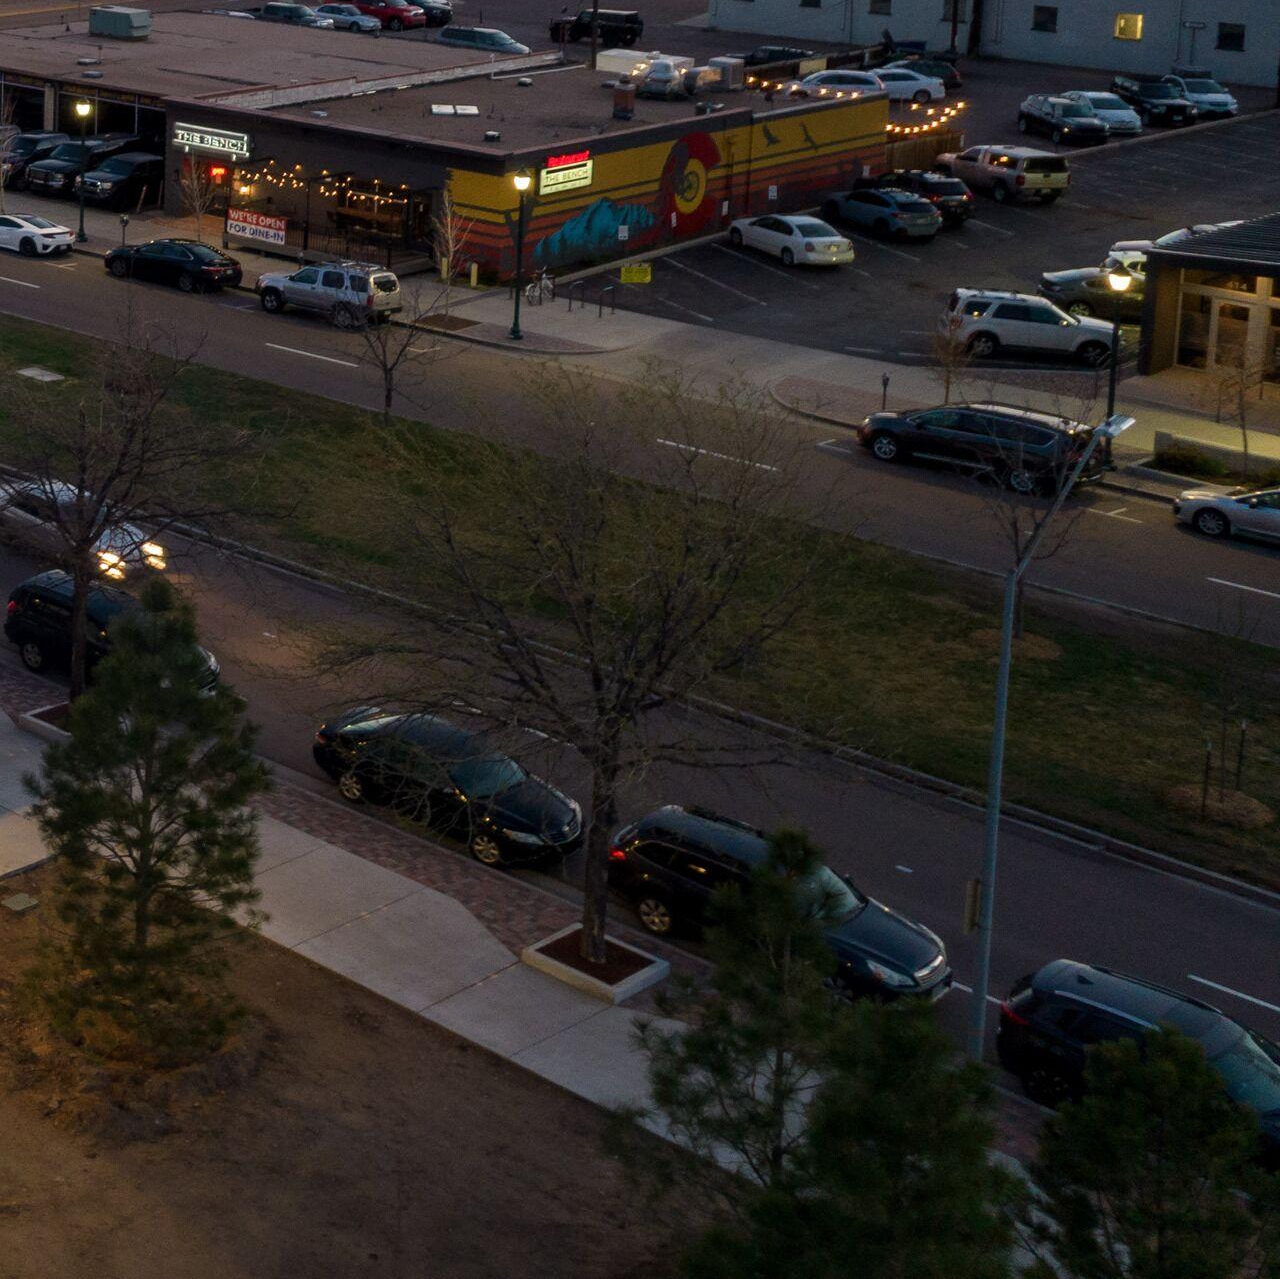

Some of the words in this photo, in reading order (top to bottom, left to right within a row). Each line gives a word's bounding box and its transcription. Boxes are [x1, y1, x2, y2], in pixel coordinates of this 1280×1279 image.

[176, 130, 201, 143] THE
[203, 135, 246, 151] BENCH
[545, 174, 559, 185] THE
[562, 168, 588, 179] BENCH
[229, 209, 258, 224] WE'RE
[258, 216, 285, 229] OPEN
[229, 223, 247, 233] FOR
[249, 228, 284, 242] DINE-IN
